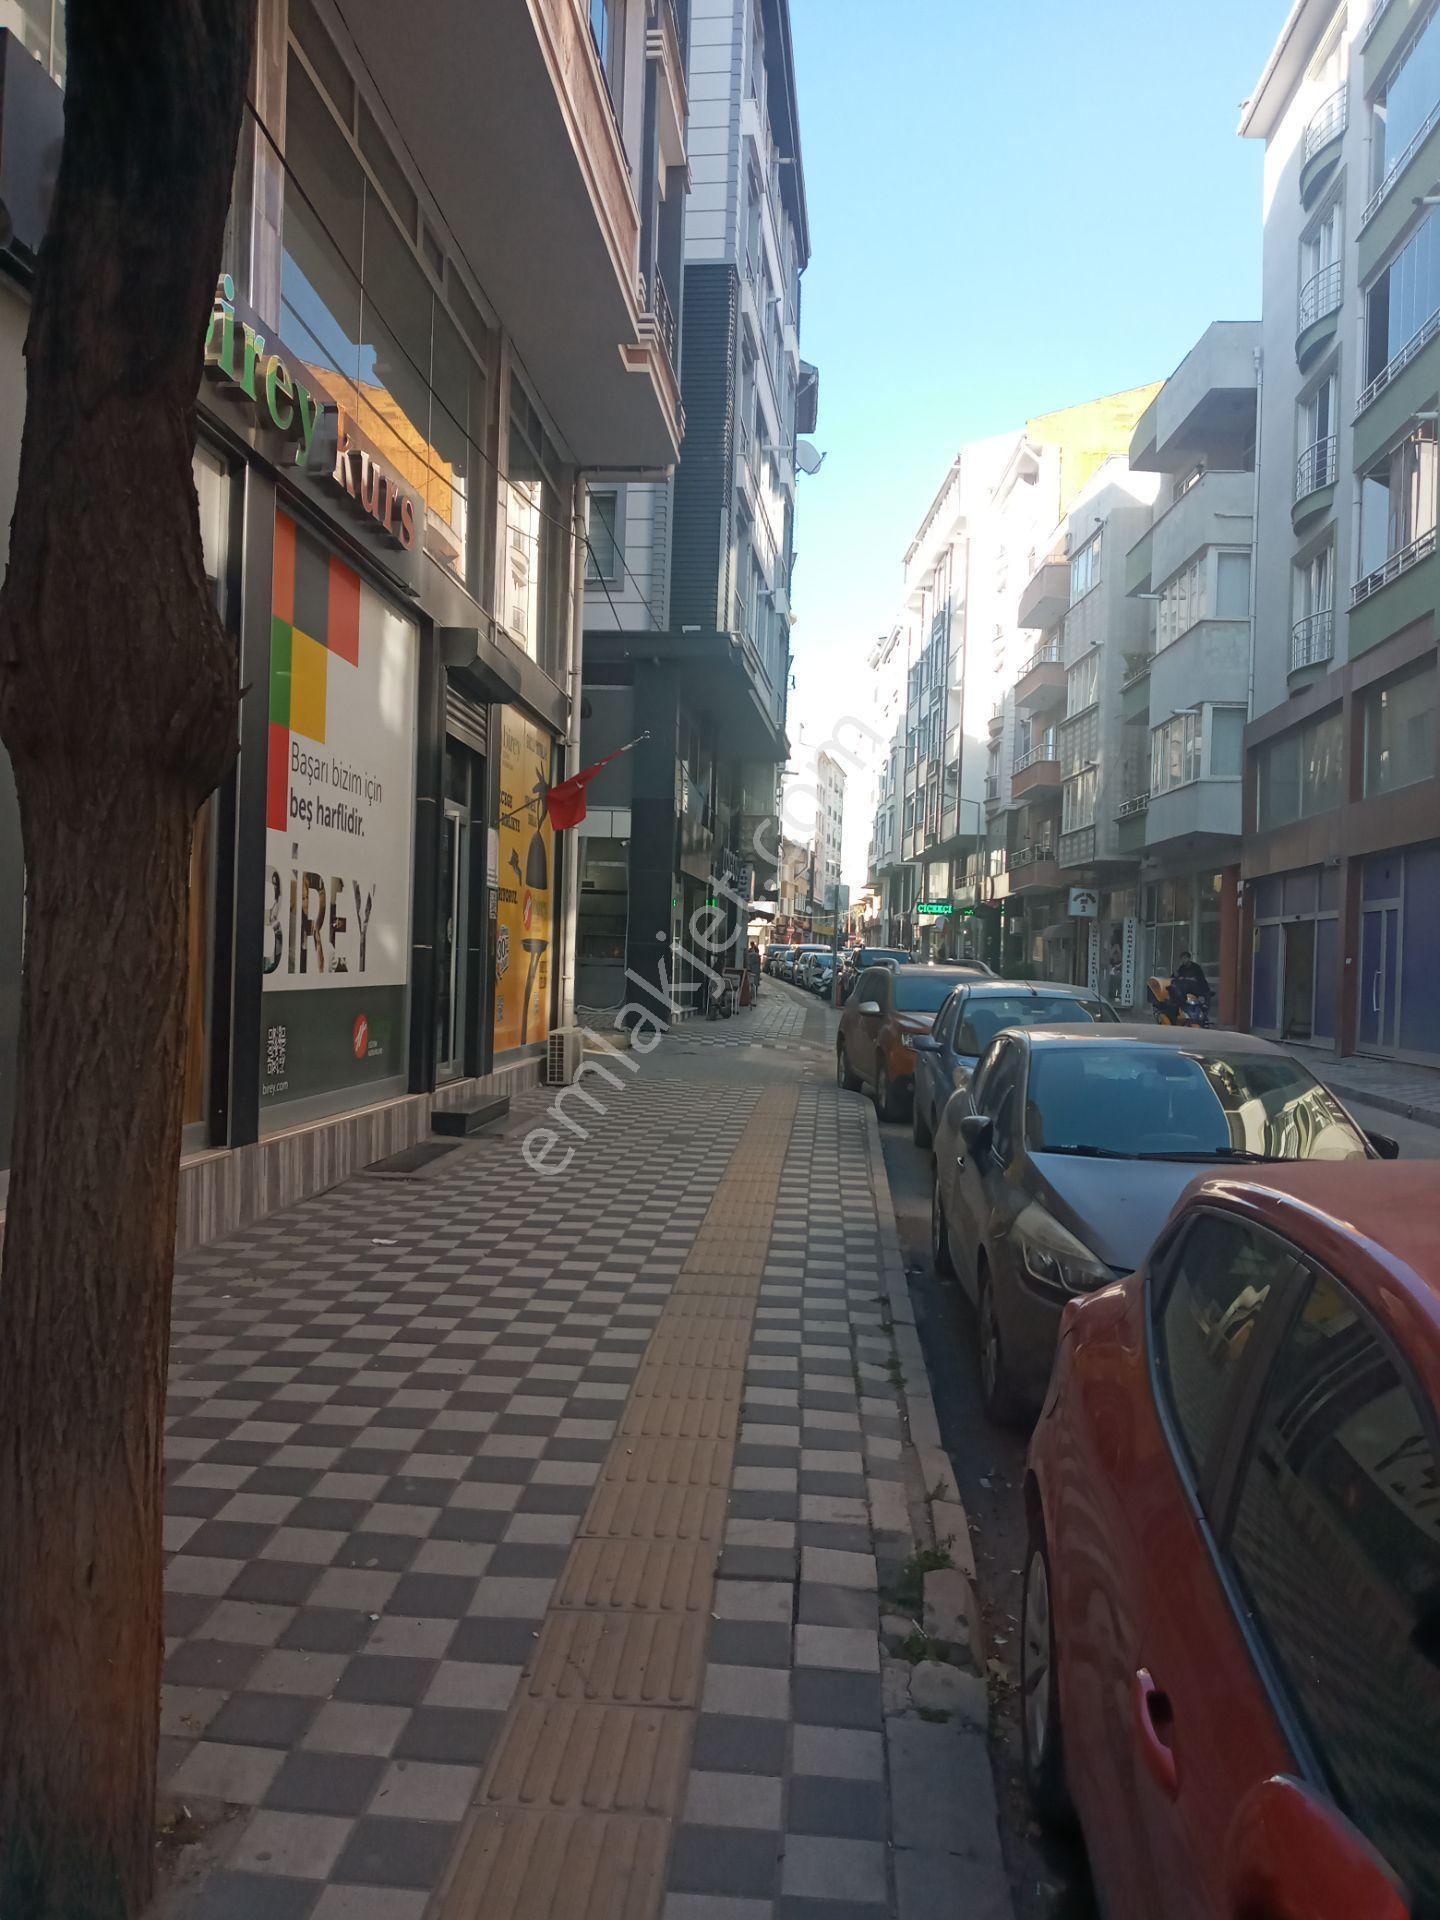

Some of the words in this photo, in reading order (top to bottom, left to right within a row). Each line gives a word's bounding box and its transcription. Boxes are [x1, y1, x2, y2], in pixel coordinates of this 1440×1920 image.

[205, 273, 324, 466] irey
[291, 741, 329, 786] Başarı
[333, 757, 363, 795] bizim
[364, 772, 383, 807] için
[290, 787, 313, 830] beş
[316, 796, 365, 837] harflidir.
[263, 842, 376, 975] BİREY
[262, 1080, 289, 1096] birey.com
